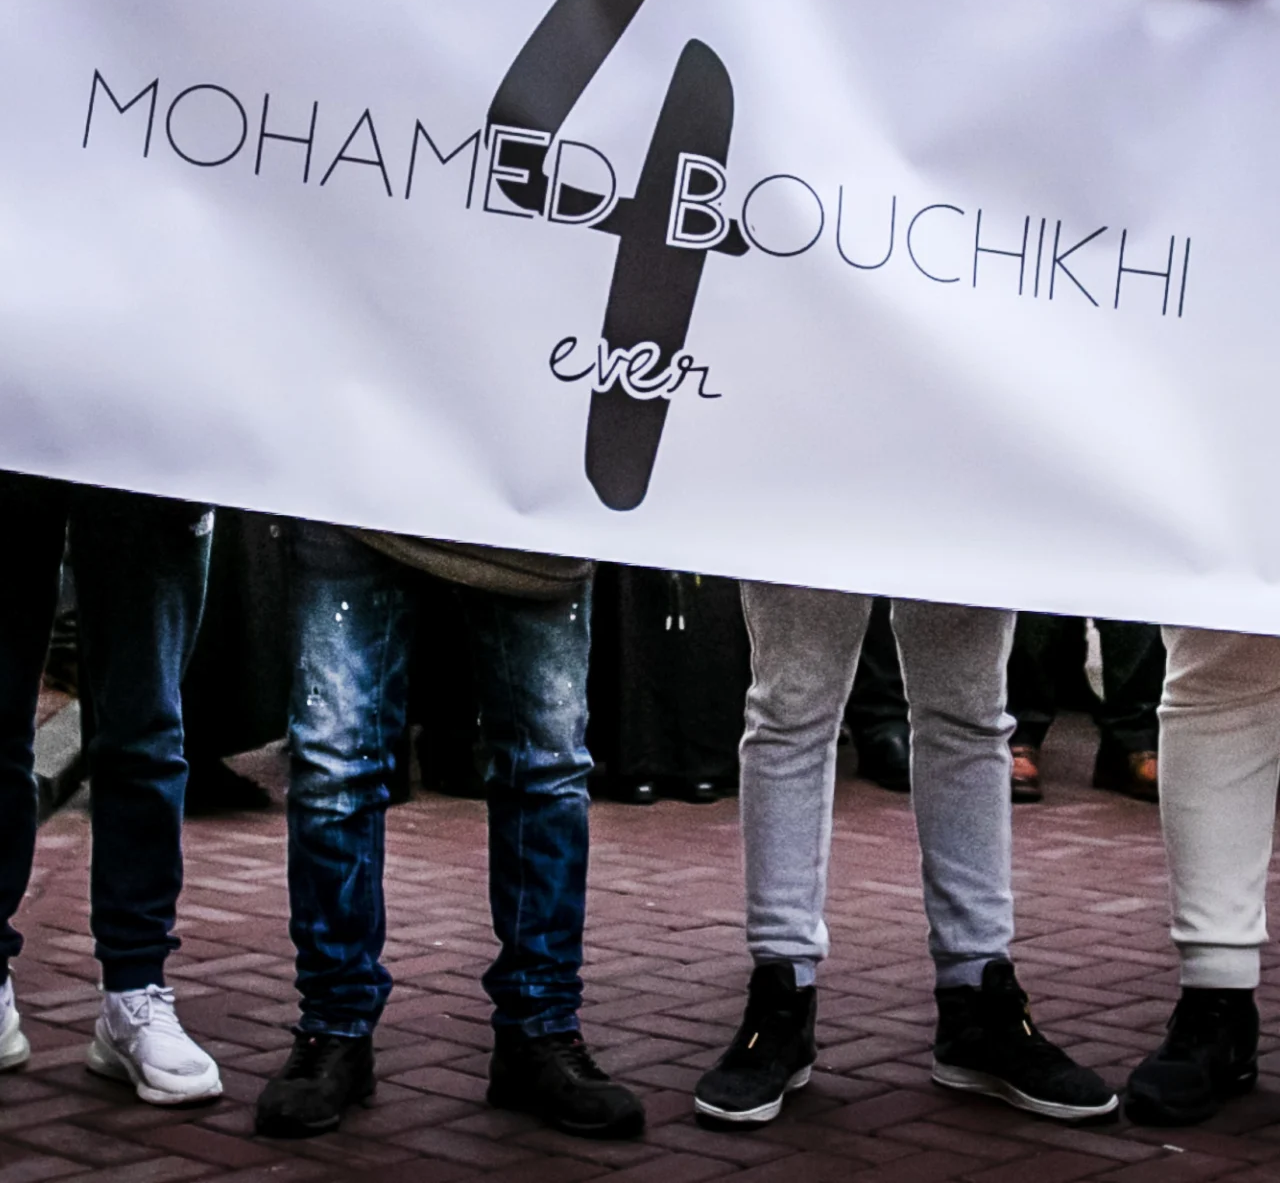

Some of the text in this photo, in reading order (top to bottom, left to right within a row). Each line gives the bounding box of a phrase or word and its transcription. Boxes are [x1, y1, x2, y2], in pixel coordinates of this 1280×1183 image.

[83, 68, 1191, 318] MOHAMED BOUCHIKHI
[548, 335, 723, 399] ever
